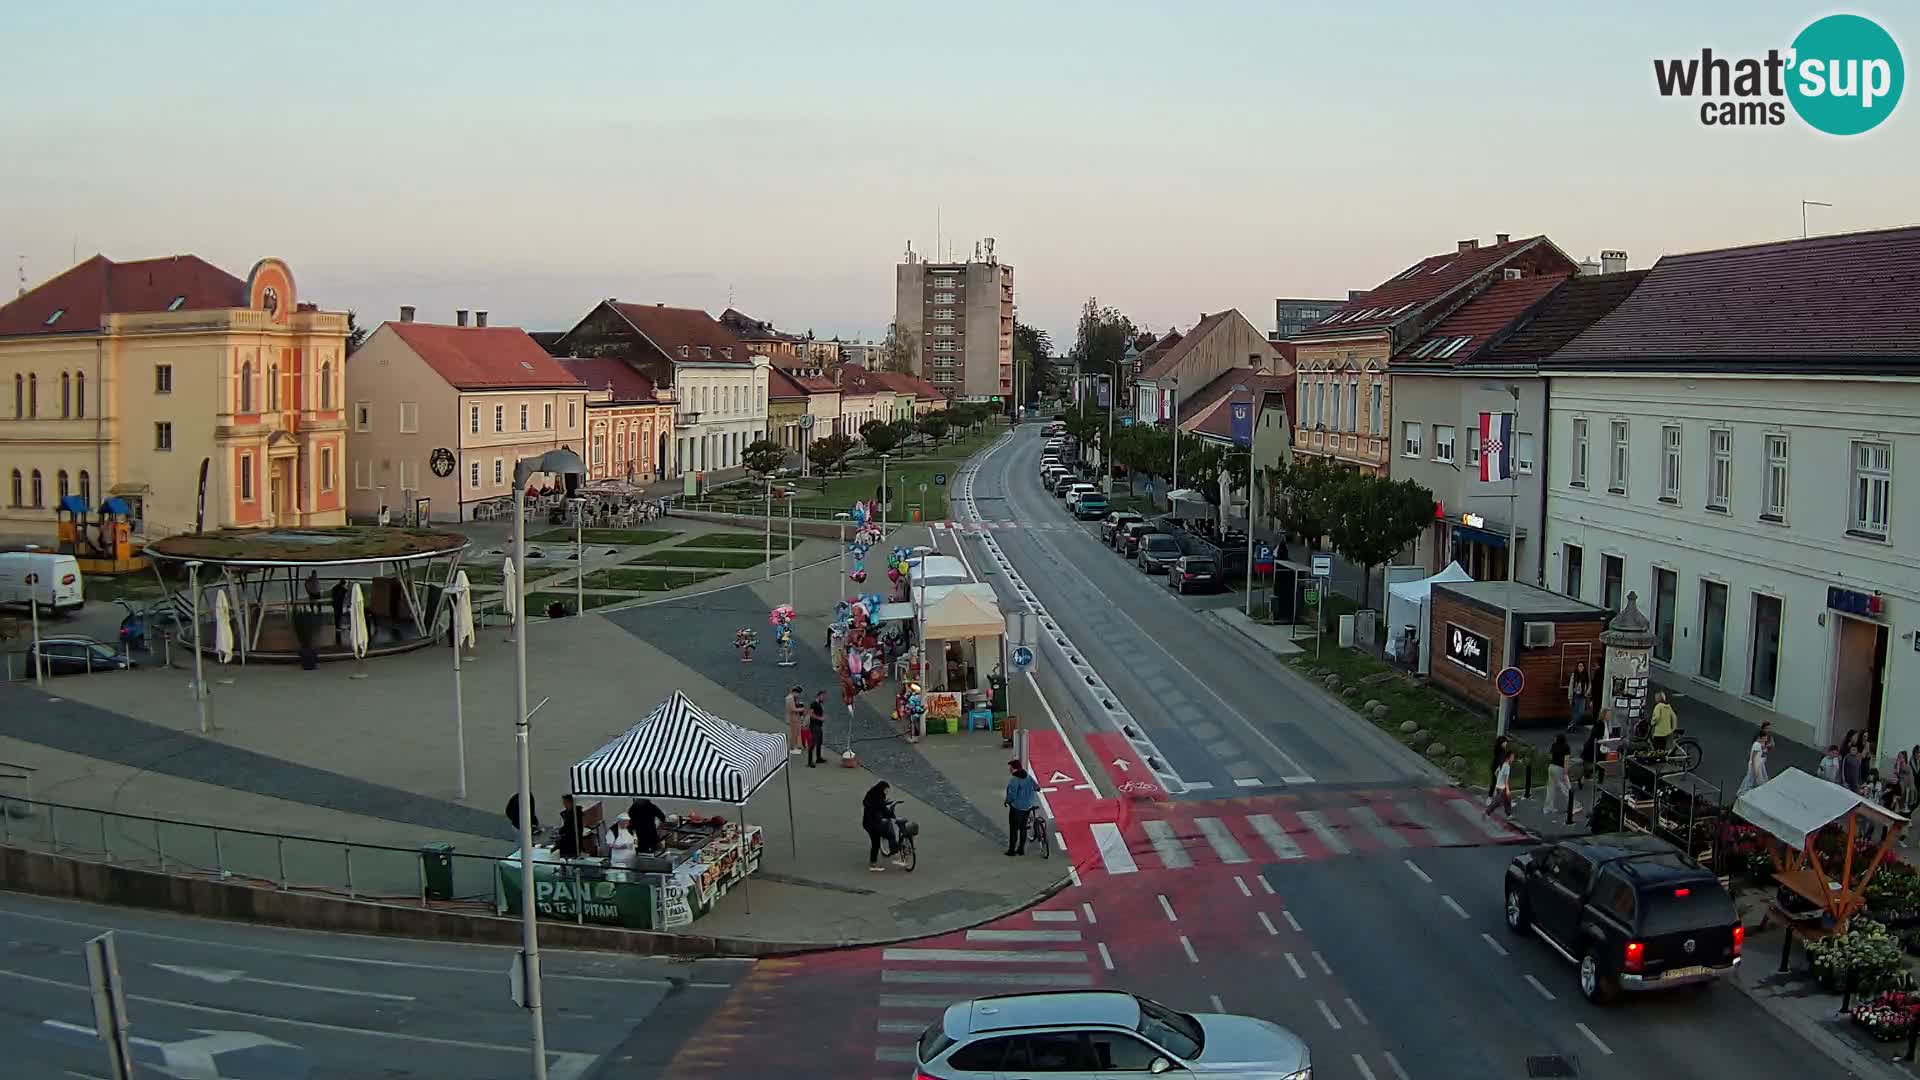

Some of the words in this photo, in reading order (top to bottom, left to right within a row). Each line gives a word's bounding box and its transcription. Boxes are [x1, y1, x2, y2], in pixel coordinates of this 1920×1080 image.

[1260, 547, 1270, 559] P
[536, 881, 592, 902] PAN
[537, 902, 552, 913] TO
[553, 903, 567, 913] TE
